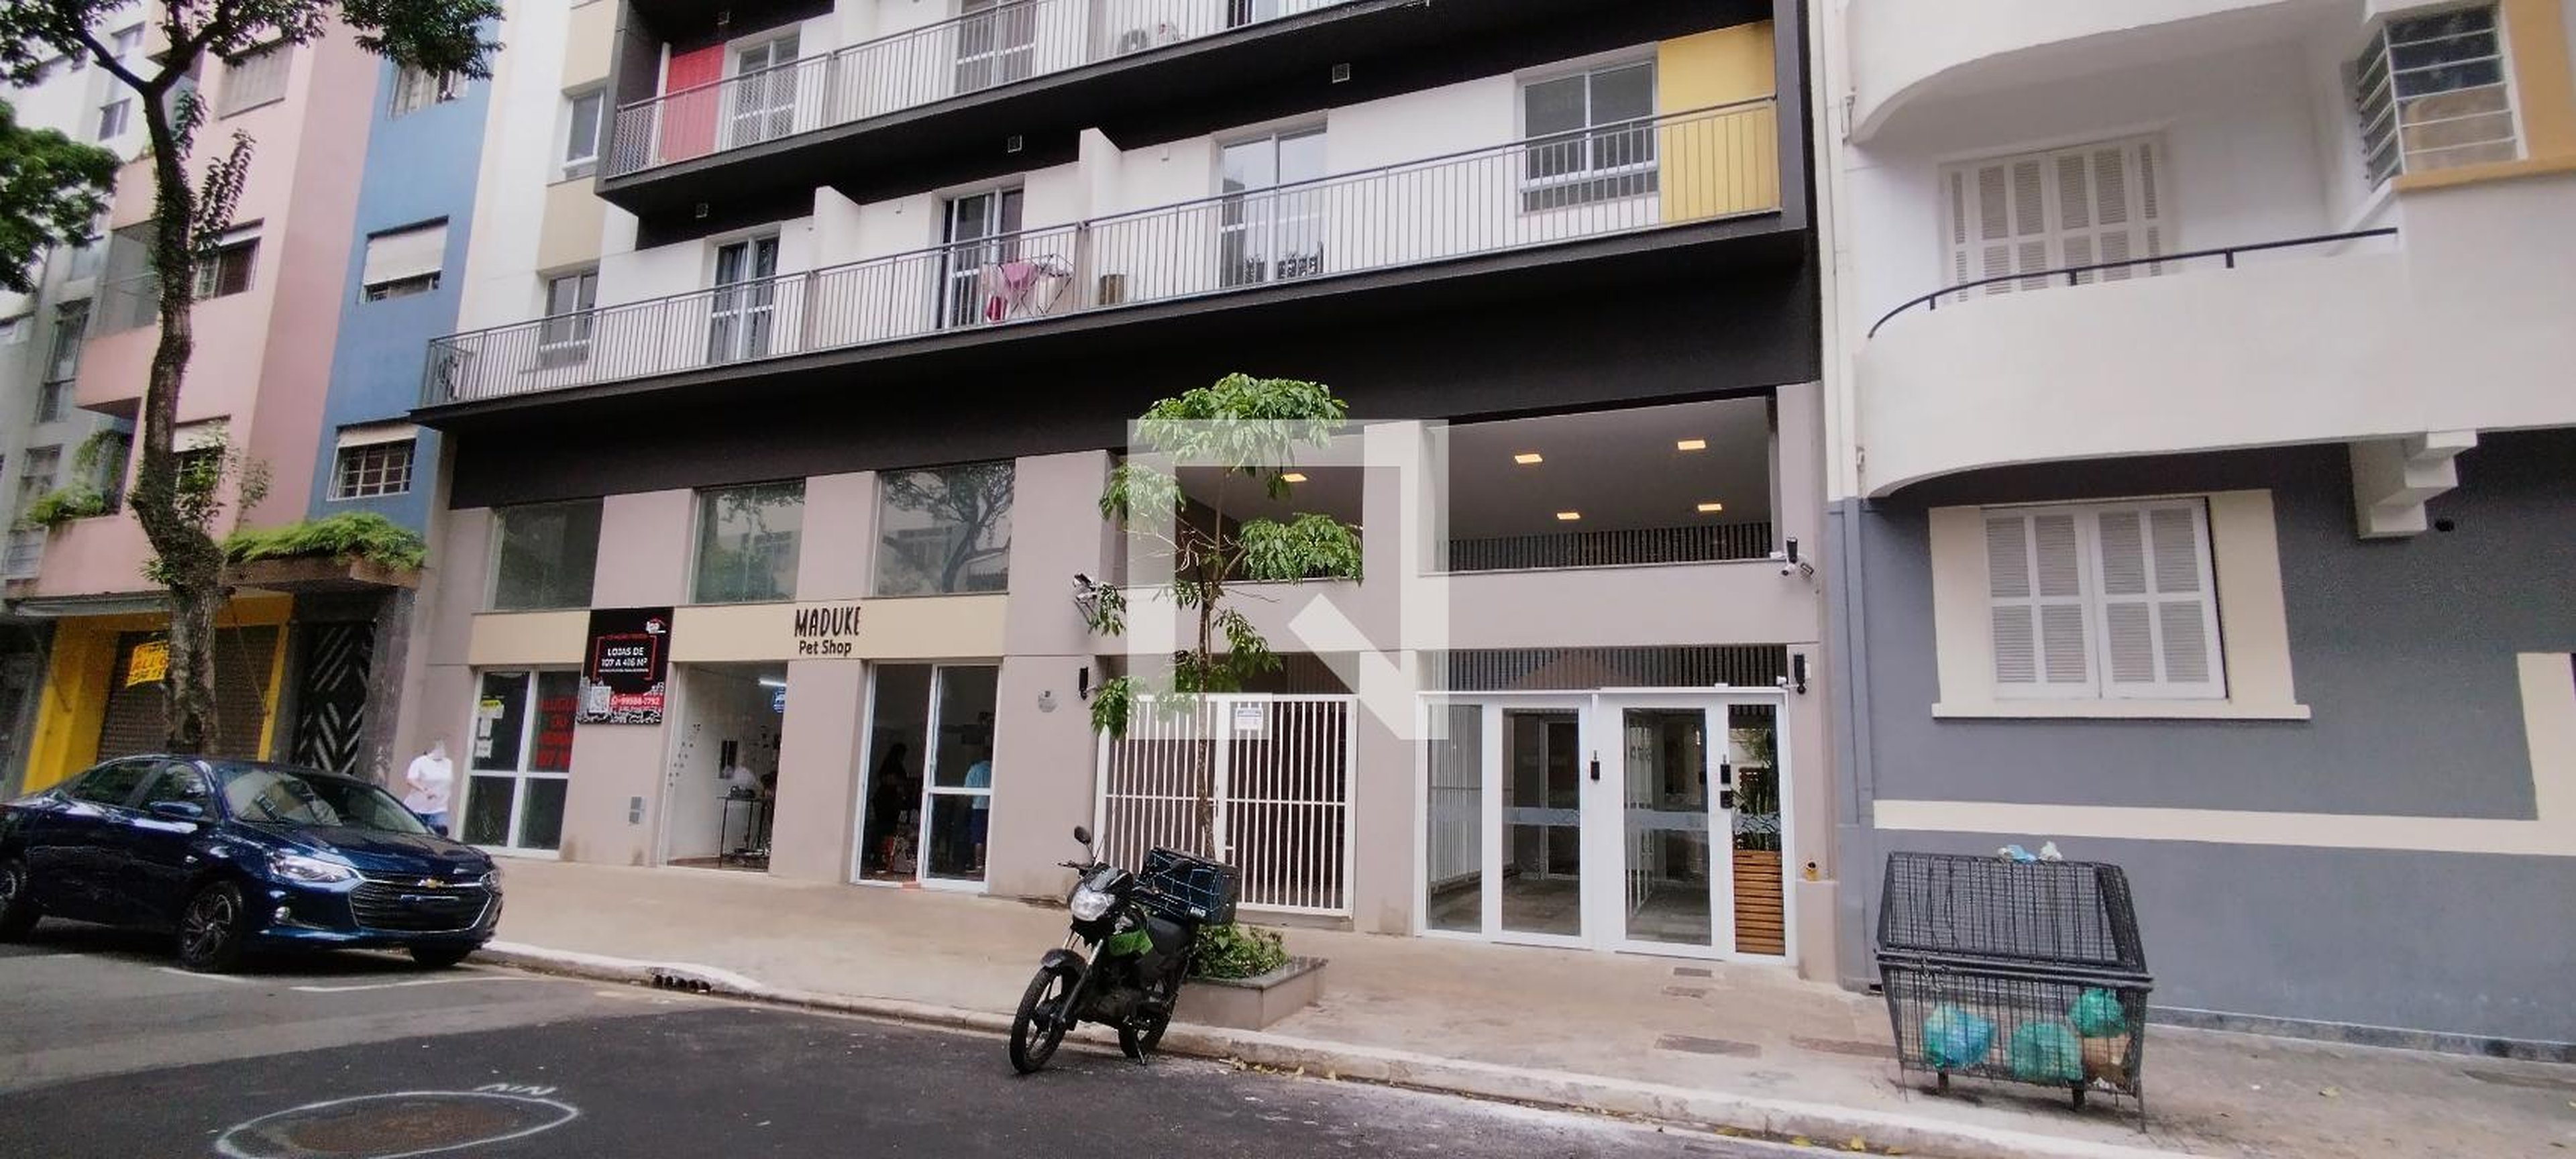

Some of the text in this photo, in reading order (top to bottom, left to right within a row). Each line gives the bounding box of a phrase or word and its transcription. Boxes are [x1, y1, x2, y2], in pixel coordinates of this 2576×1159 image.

[794, 606, 861, 637] MADUKE
[633, 647, 645, 656] DE
[799, 639, 852, 657] Pet Shop
[614, 658, 621, 667] A
